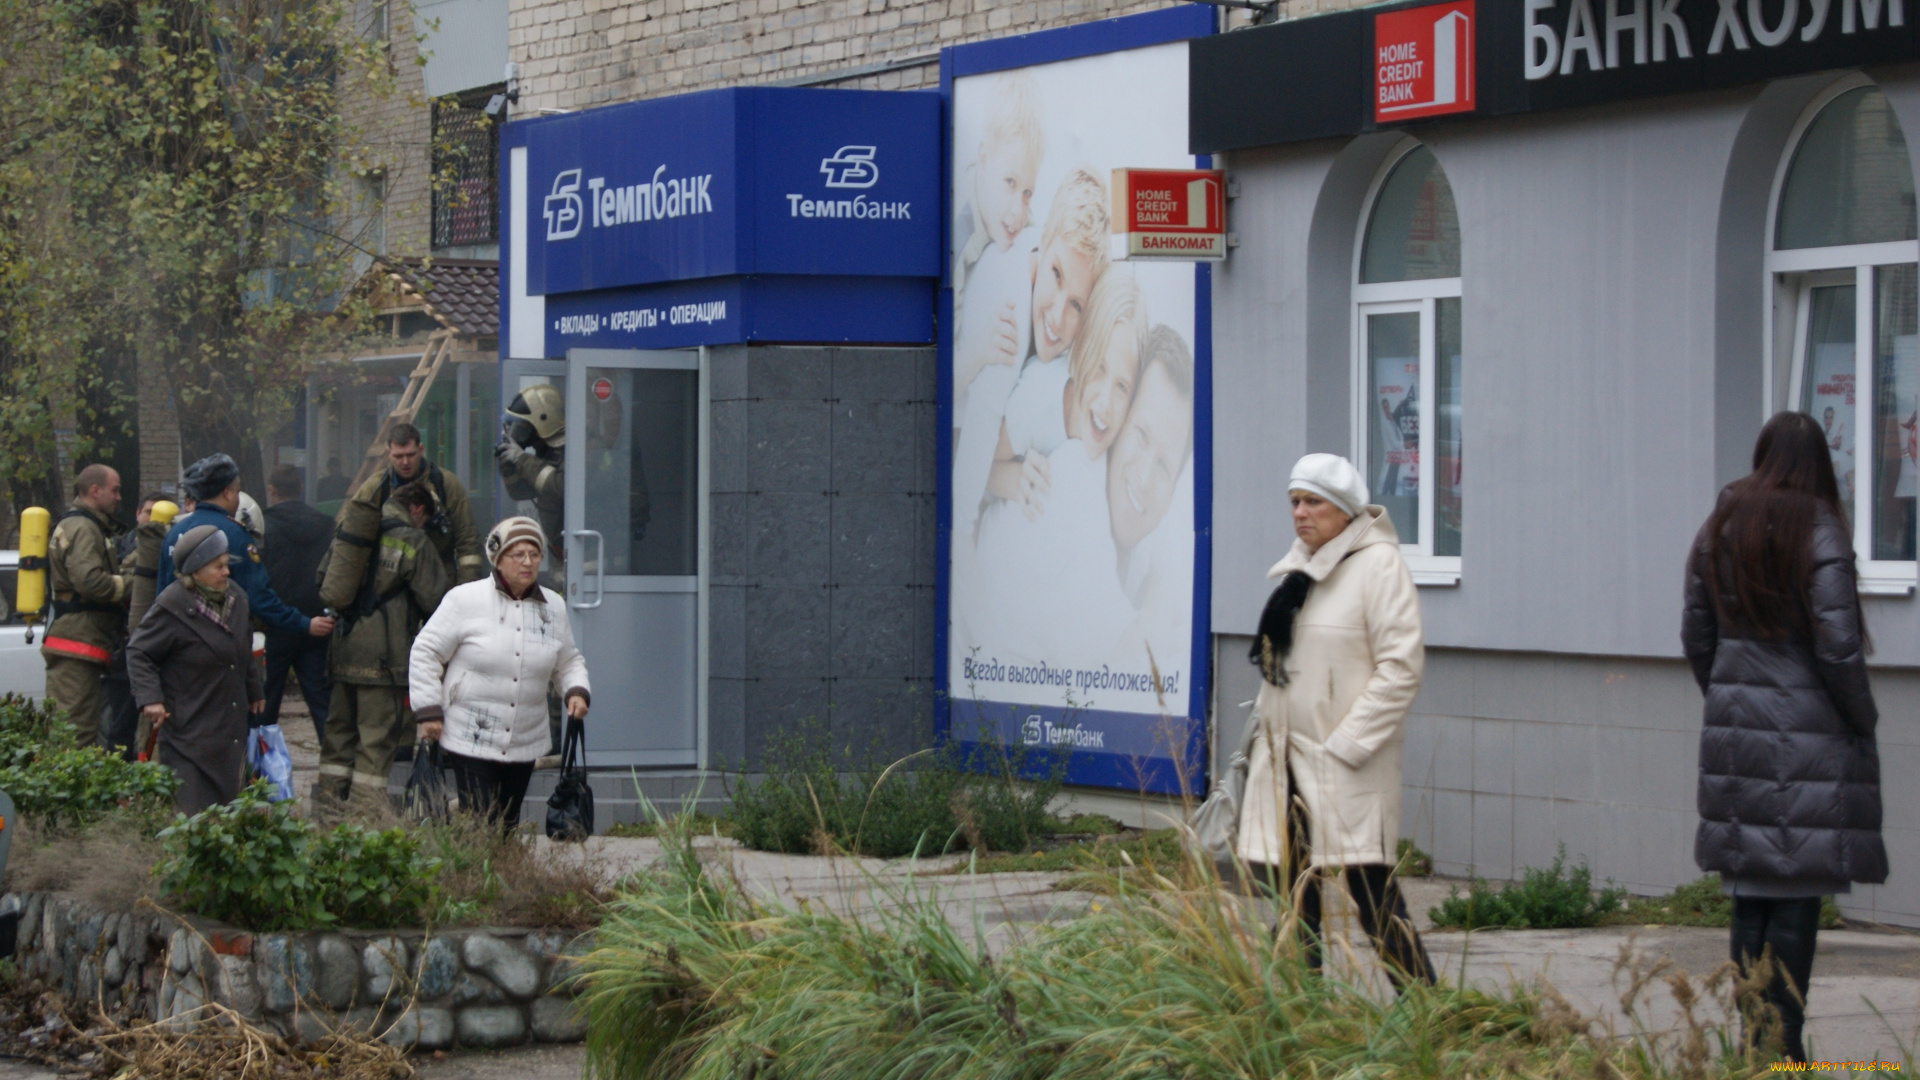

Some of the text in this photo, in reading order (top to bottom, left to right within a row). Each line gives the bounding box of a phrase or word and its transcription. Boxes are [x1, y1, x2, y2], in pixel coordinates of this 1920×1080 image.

[1524, 0, 1694, 80] БАНК
[1379, 41, 1417, 64] HOME
[1379, 60, 1424, 84] CREDIT
[1379, 81, 1414, 104] BANK
[588, 164, 713, 230] Темпбанк
[786, 194, 911, 219] Темпбанк
[1136, 190, 1172, 200] HOME
[1136, 201, 1178, 212] CREDIT
[1136, 212, 1170, 223] BANK
[1142, 236, 1215, 250] БАНКОМАТ
[560, 300, 726, 336] ВКЛАДЫ КРЕДИТЫ ОПЕРАЦИИ
[964, 657, 1005, 683] Всегда
[1008, 660, 1073, 687] выгодные
